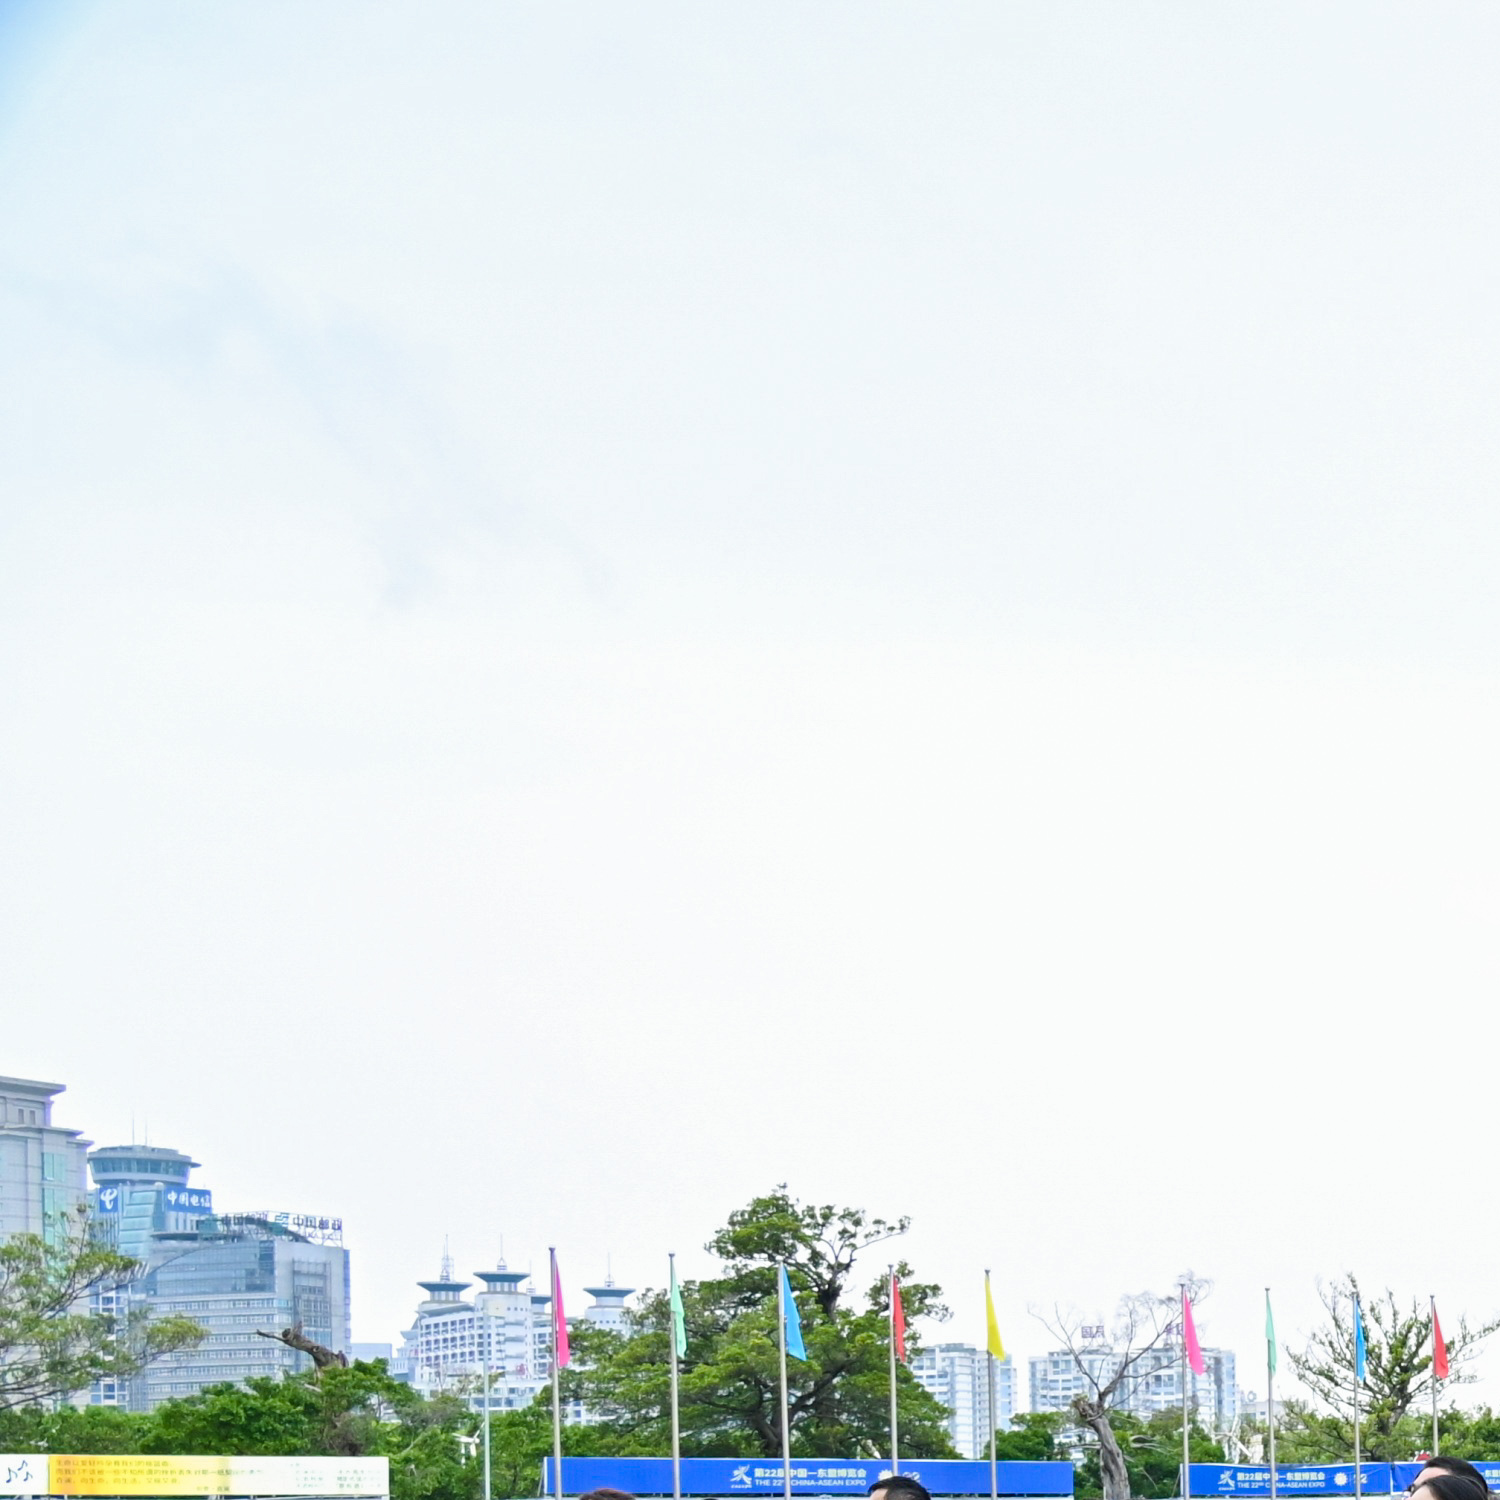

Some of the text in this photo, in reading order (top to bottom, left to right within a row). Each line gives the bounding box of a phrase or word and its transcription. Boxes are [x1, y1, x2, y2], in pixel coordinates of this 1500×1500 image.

[167, 1190, 212, 1207] 中国电信
[791, 1479, 844, 1487] CHINA-ASEAN
[845, 1479, 867, 1487] EXPO
